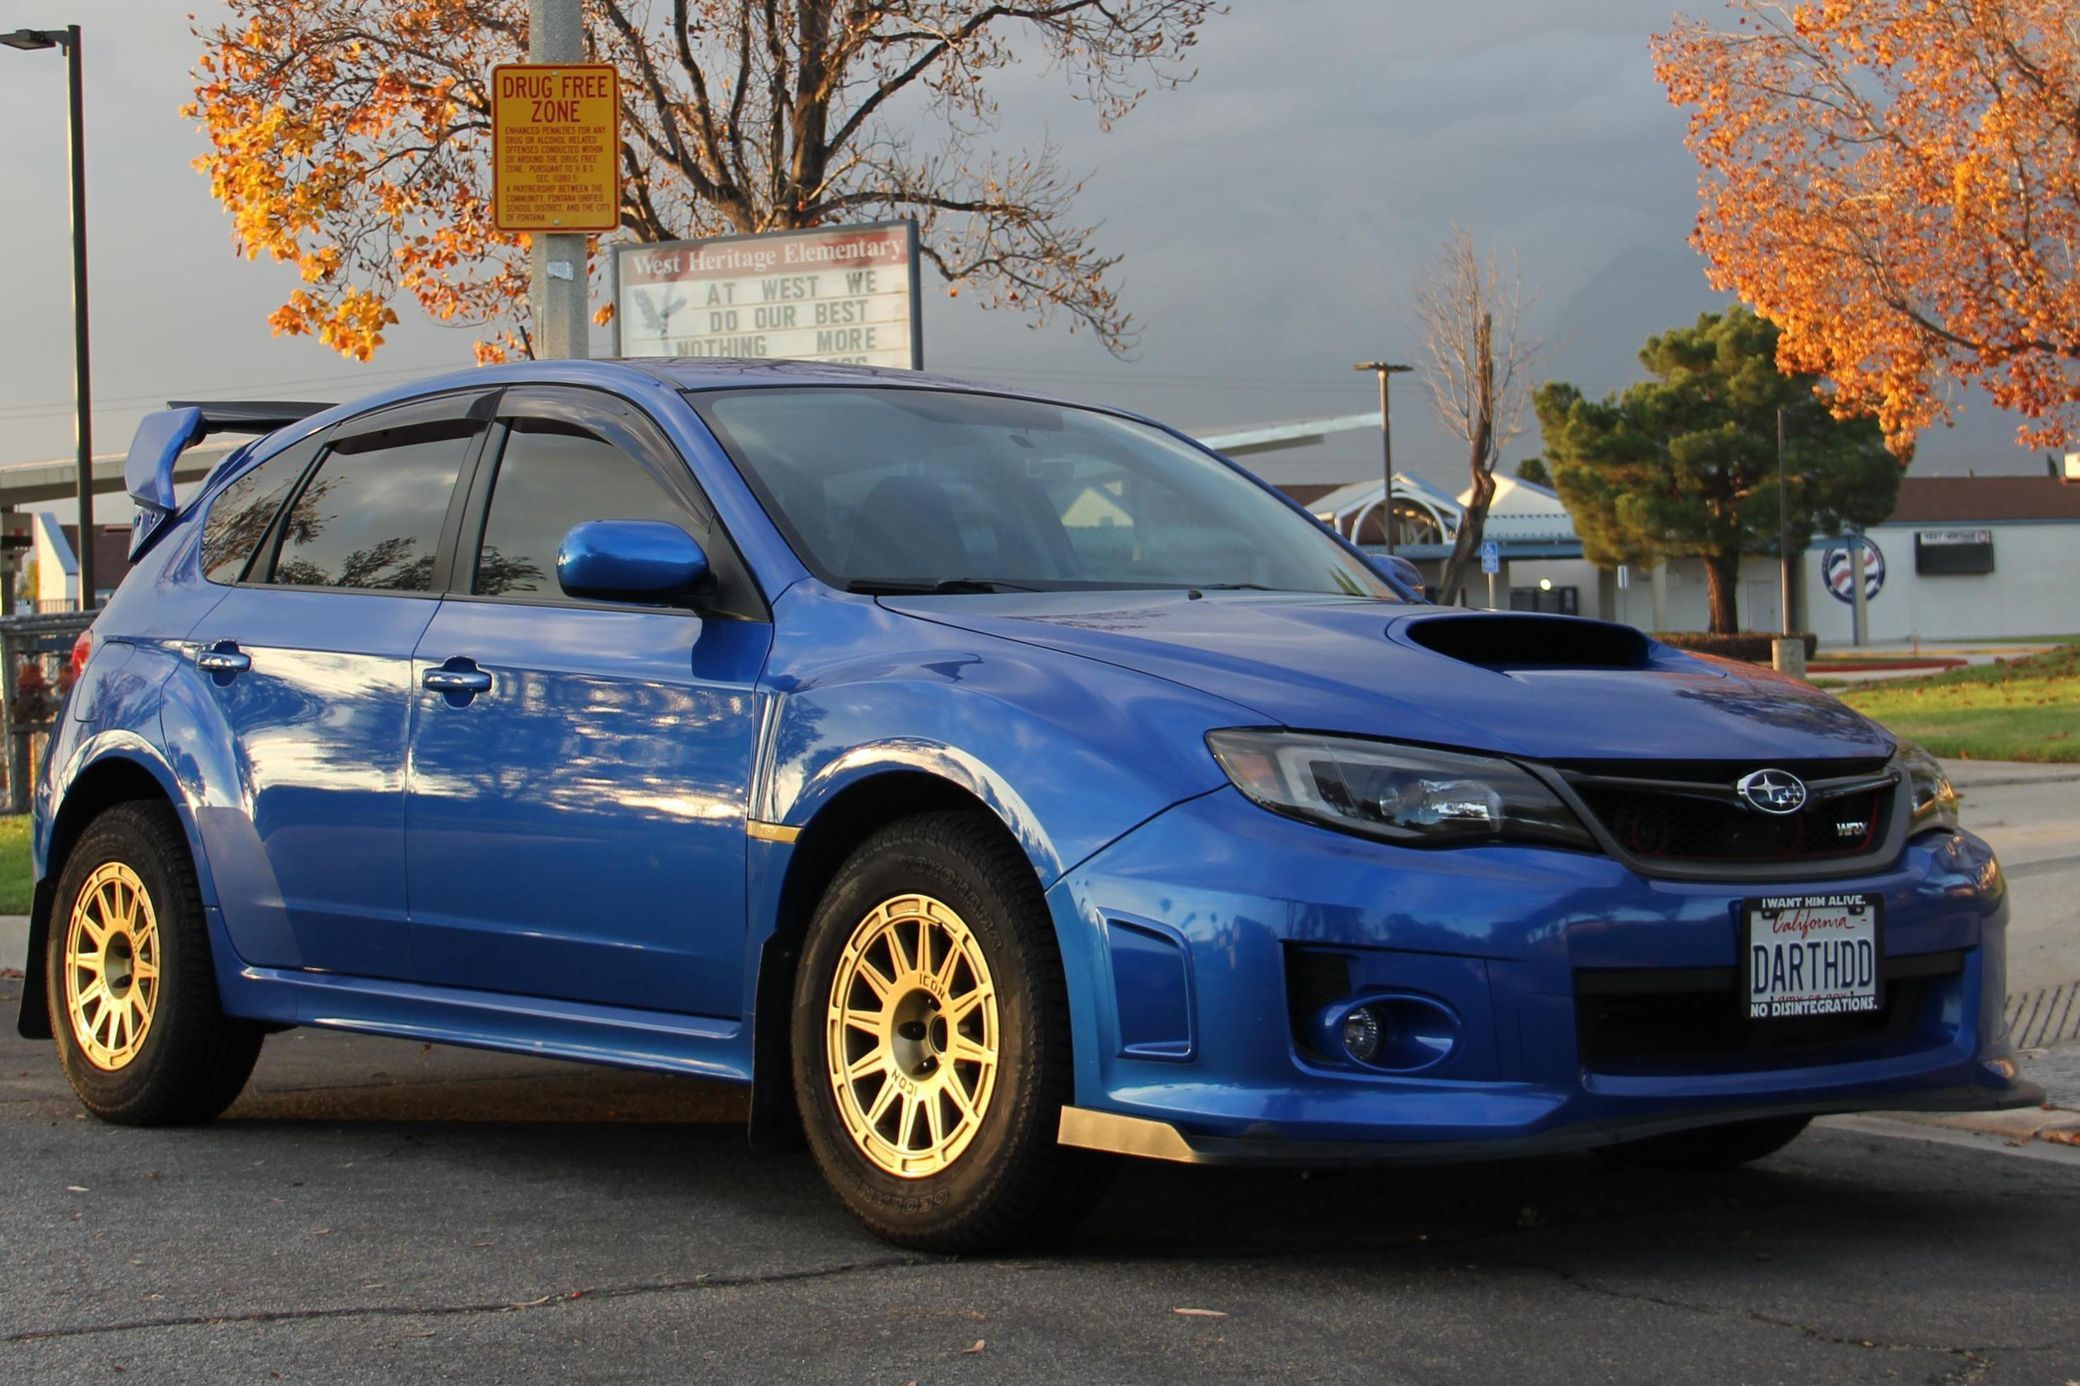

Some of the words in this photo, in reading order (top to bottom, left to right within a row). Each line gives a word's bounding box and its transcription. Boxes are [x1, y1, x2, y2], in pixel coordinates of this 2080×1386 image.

[503, 76, 552, 98] DRUG
[562, 76, 608, 98] FREE
[532, 101, 580, 122] ZONE
[505, 127, 539, 135] ENHANCED
[542, 127, 576, 135] PENALTIES
[578, 127, 591, 135] FOR
[593, 127, 606, 135] ANY
[505, 136, 523, 144] DRUG
[526, 136, 535, 144] OR
[537, 136, 565, 144] ALCOHOL
[568, 136, 597, 144] RELATED
[505, 145, 539, 154] OFFENSES
[542, 145, 580, 154] CONDUCTED
[582, 145, 604, 154] WITHIN
[505, 155, 514, 163] OR
[517, 155, 544, 163] AROUND
[546, 155, 557, 163] THE
[560, 155, 578, 163] DRUG
[580, 155, 597, 163] FREE
[529, 165, 562, 173] PURSUANT
[565, 165, 573, 173] TO
[513, 184, 556, 192] PARTNERSHIP
[558, 184, 589, 192] BETWEEN
[592, 184, 603, 192] THE
[548, 194, 576, 203] FONTANA
[579, 194, 604, 203] UNIFIED
[506, 204, 531, 212] SCHOOL
[566, 204, 579, 212] AND
[582, 204, 593, 212] THE
[596, 204, 610, 212] CITY
[633, 254, 681, 275] West
[688, 249, 777, 271] Heritage
[783, 238, 905, 264] Elementary
[706, 283, 736, 306] AT
[761, 275, 819, 301] WEST
[846, 270, 878, 294] WE
[709, 310, 739, 333] DO
[754, 305, 797, 329] OUR
[814, 299, 869, 325] BEST
[677, 335, 767, 357] NOTHING
[816, 327, 877, 354] MORE
[1836, 821, 1868, 836] WRX
[897, 855, 1002, 952] YOKOHAMA
[1767, 897, 1802, 908] WANT
[1805, 896, 1826, 906] HIM
[1828, 894, 1866, 905] ALIVE.
[1772, 908, 1855, 939] California
[1752, 939, 1873, 994] DARTHDD
[919, 972, 946, 1000] ICON
[1750, 1001, 1768, 1018] NO
[1772, 996, 1878, 1016] DISINTEGRATIONS.
[892, 1067, 919, 1098] ICON
